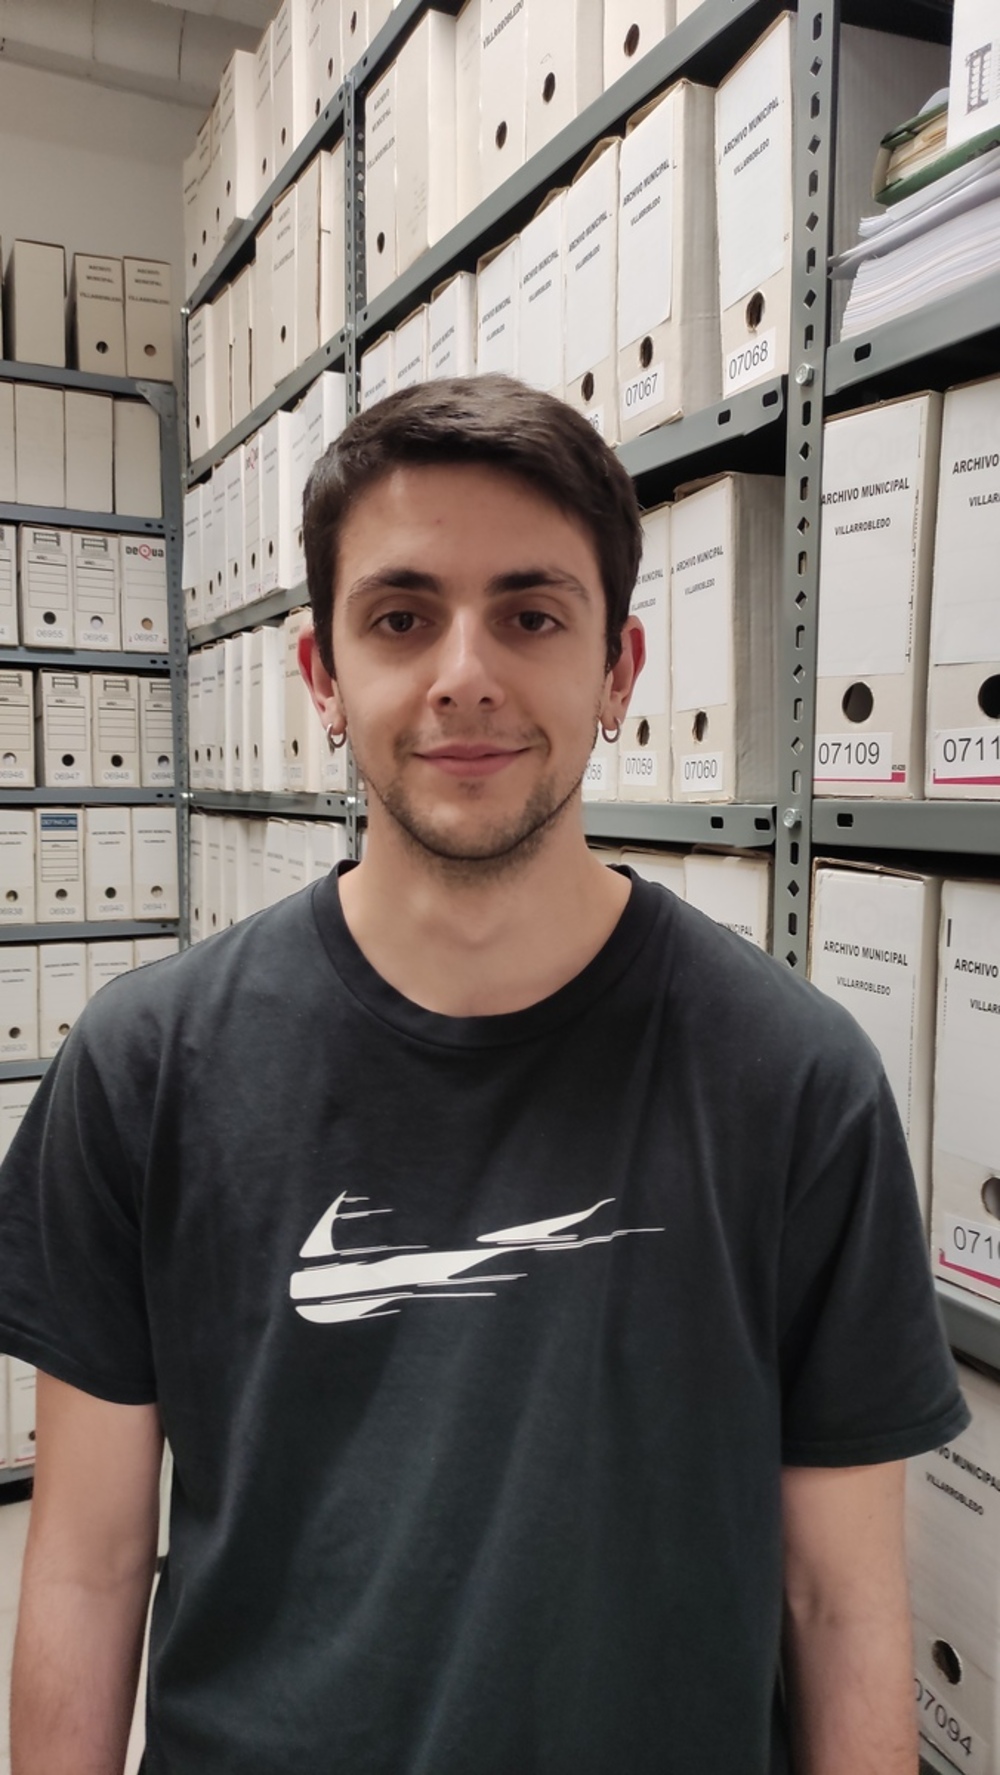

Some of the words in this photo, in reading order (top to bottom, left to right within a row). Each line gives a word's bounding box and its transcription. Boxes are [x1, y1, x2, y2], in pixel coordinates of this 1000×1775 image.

[723, 125, 749, 157] ARCHIVO
[748, 96, 780, 134] MUNICIPAL
[733, 138, 770, 176] VILLARROBLEDO
[622, 181, 644, 208] ARCHIVO
[643, 158, 670, 191] MUNICIPAL
[630, 195, 662, 227] VILLARROBLEDO
[728, 339, 769, 380] 07068
[625, 372, 658, 407] 07067
[952, 453, 1000, 475] ARCHIVO
[820, 488, 860, 507] ARCHIVO
[860, 477, 911, 499] MUNICIPAL
[834, 517, 892, 537] VILLARROBLEDO
[676, 556, 697, 573] ARCHIVO
[696, 545, 724, 564] MUNICIPAL
[624, 757, 654, 776] 07059
[818, 741, 880, 765] 07109
[684, 758, 718, 780] 07060
[823, 940, 861, 958] ARCHIVO
[861, 946, 909, 967] MUNICIPAL
[953, 958, 1000, 979] ARCHIVO
[836, 976, 892, 996] VILLARROBLEDO
[953, 1225, 1000, 1260] 071
[925, 1471, 985, 1516] VILLARROBLEDO
